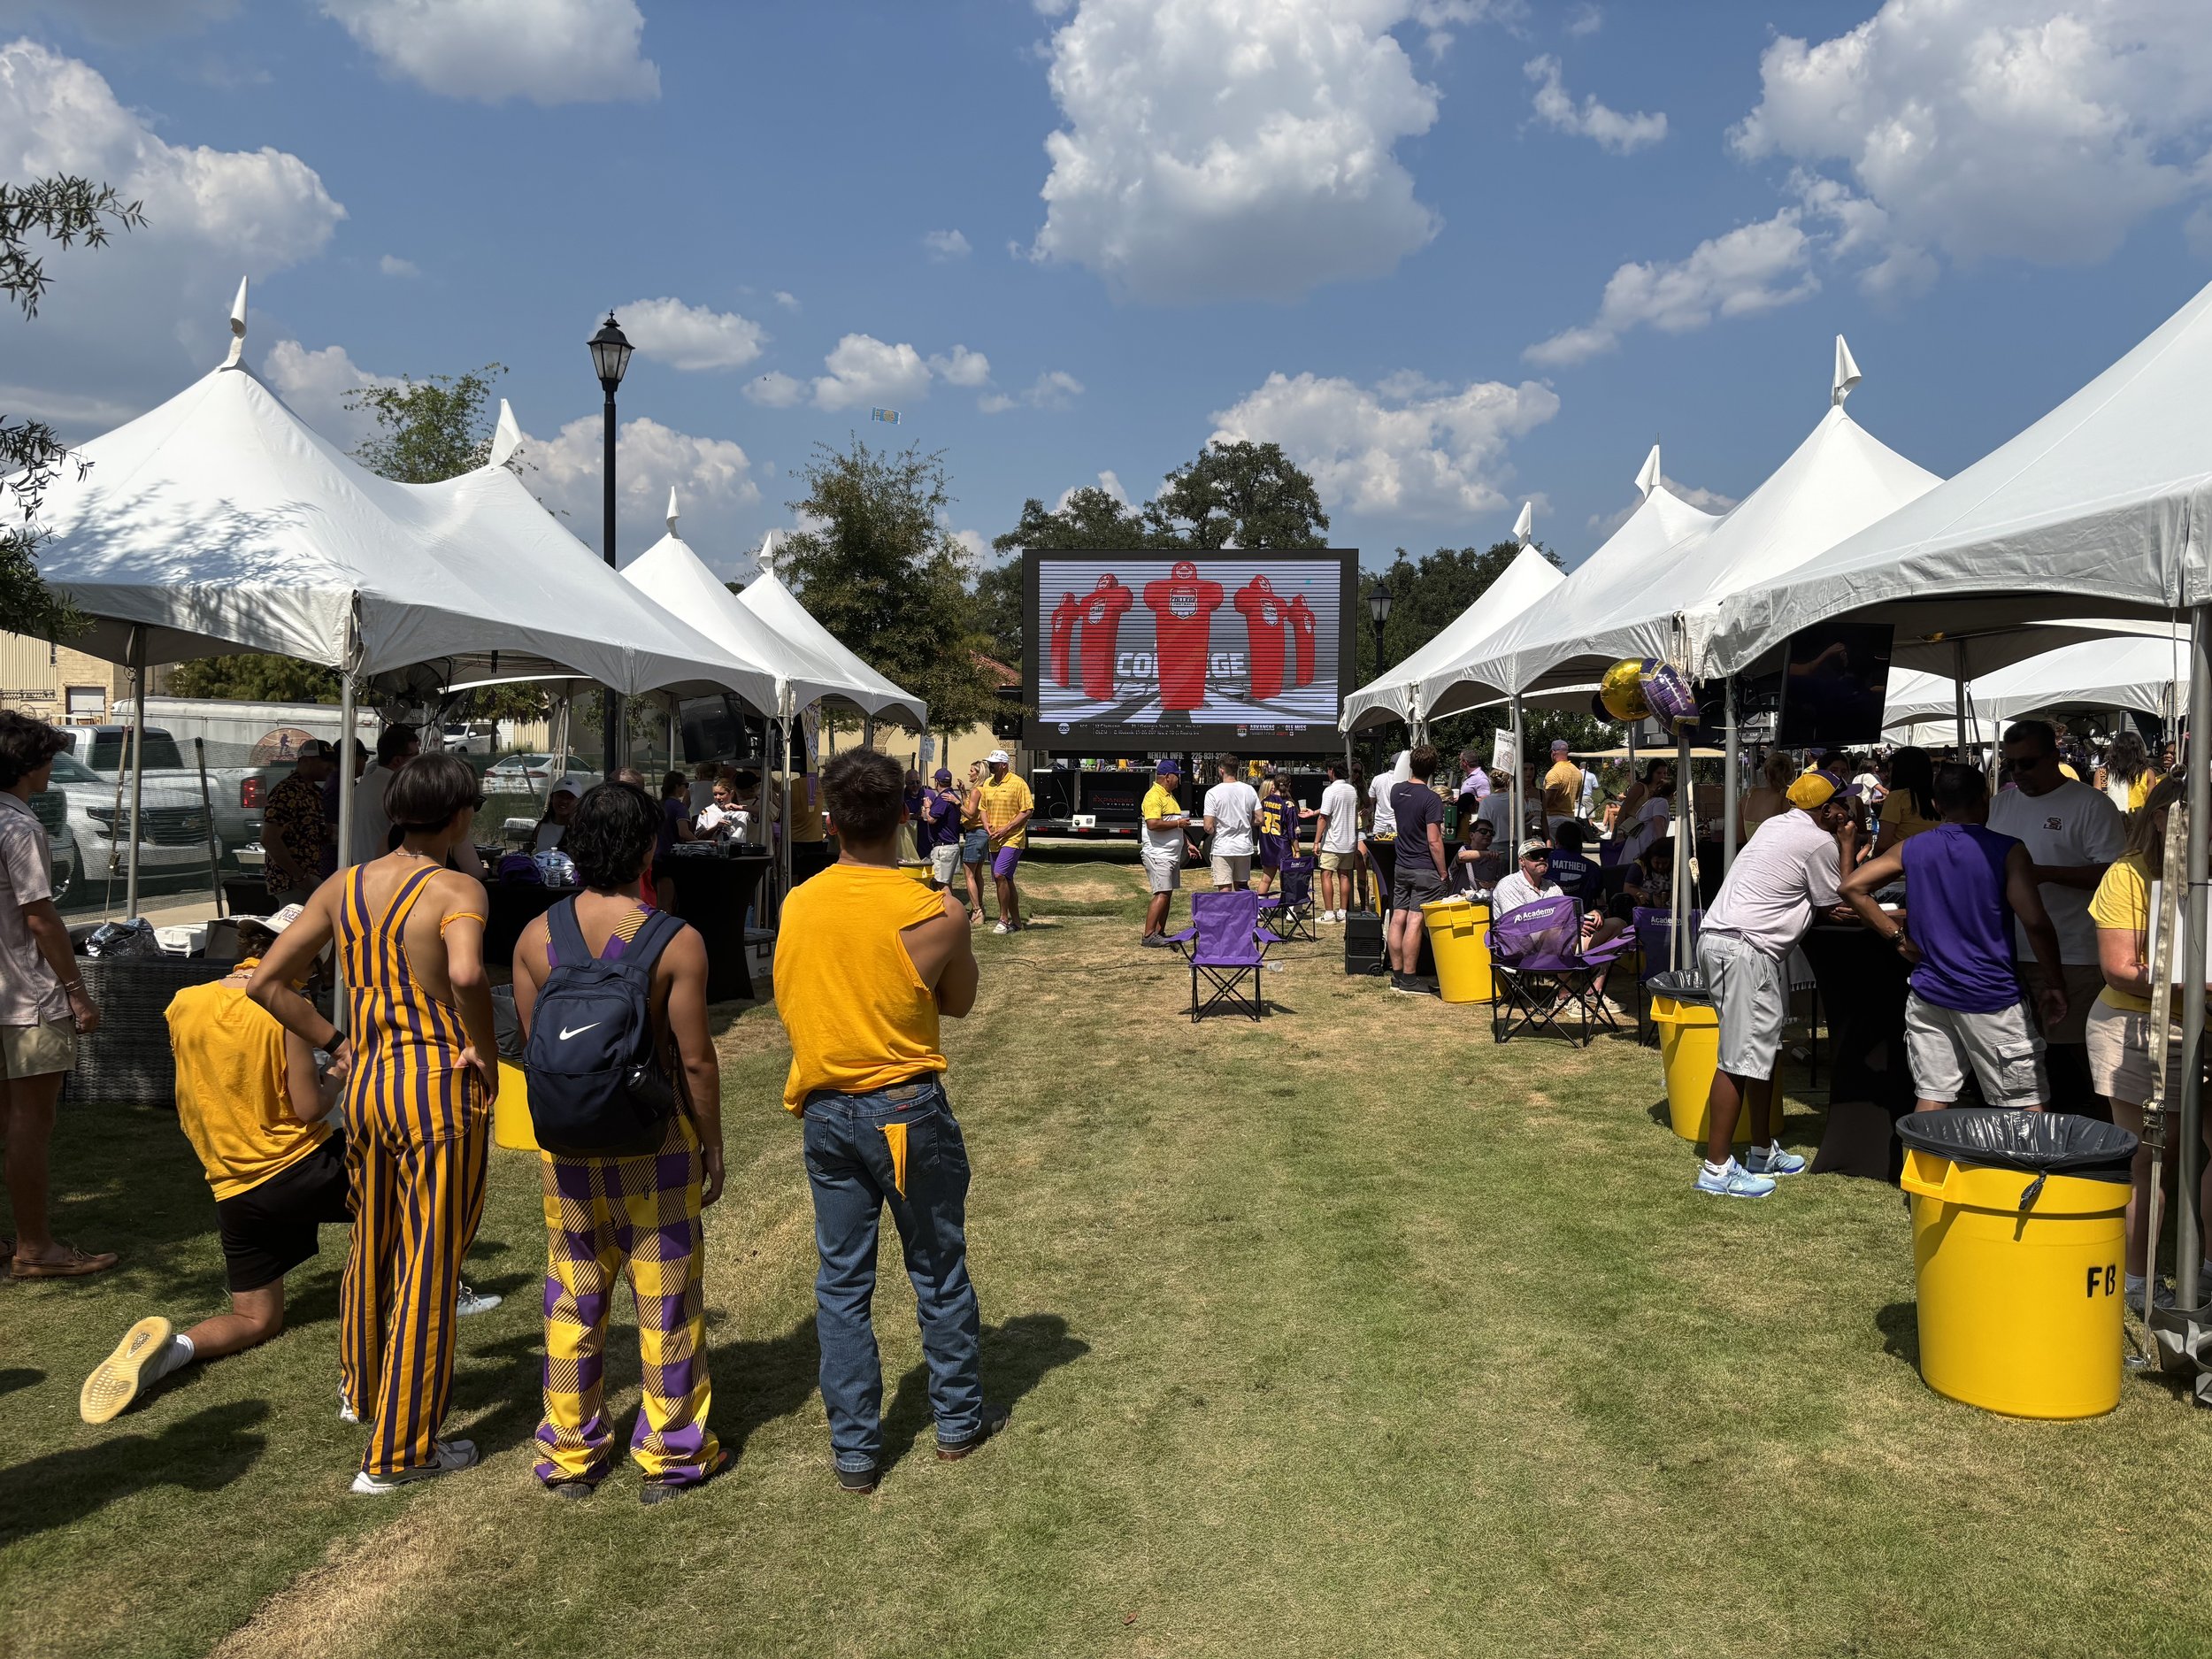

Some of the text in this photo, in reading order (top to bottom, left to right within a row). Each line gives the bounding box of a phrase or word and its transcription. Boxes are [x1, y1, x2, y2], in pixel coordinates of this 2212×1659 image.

[1263, 801, 1282, 810] TIGERS
[1261, 811, 1281, 836] 35
[1552, 859, 1587, 872] MATHIEU
[1523, 907, 1555, 919] Academy
[2086, 1265, 2116, 1298] FB
